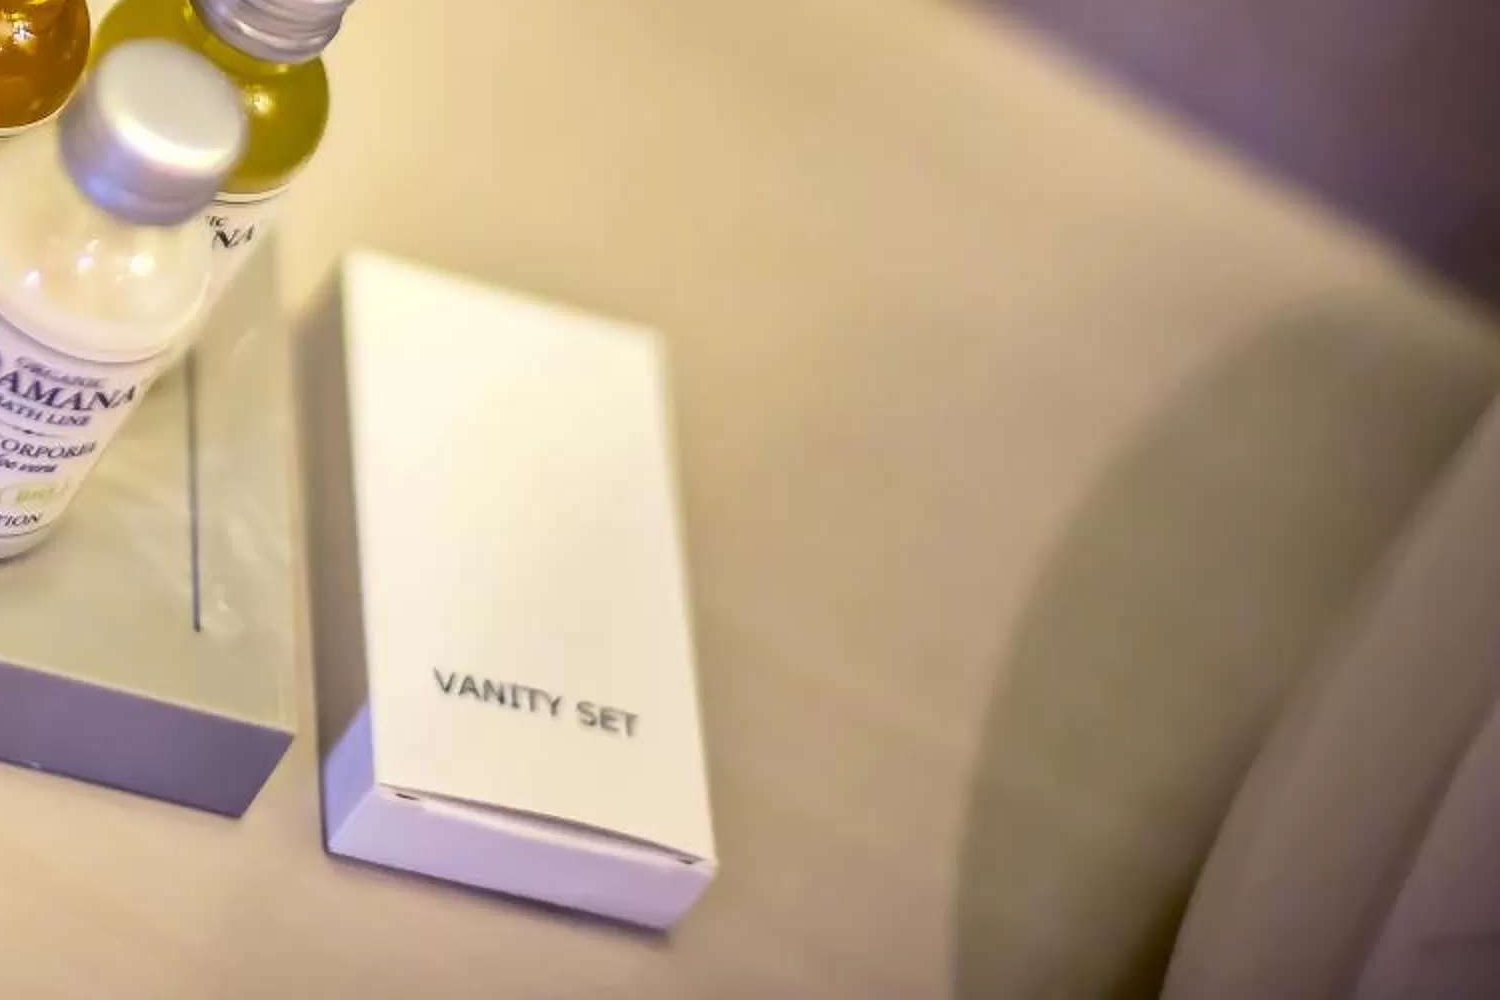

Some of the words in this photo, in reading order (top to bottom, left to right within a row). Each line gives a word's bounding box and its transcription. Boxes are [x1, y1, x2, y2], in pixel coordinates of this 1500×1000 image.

[45, 413, 92, 427] LINE
[432, 665, 564, 717] VANITY
[575, 700, 640, 738] SET
